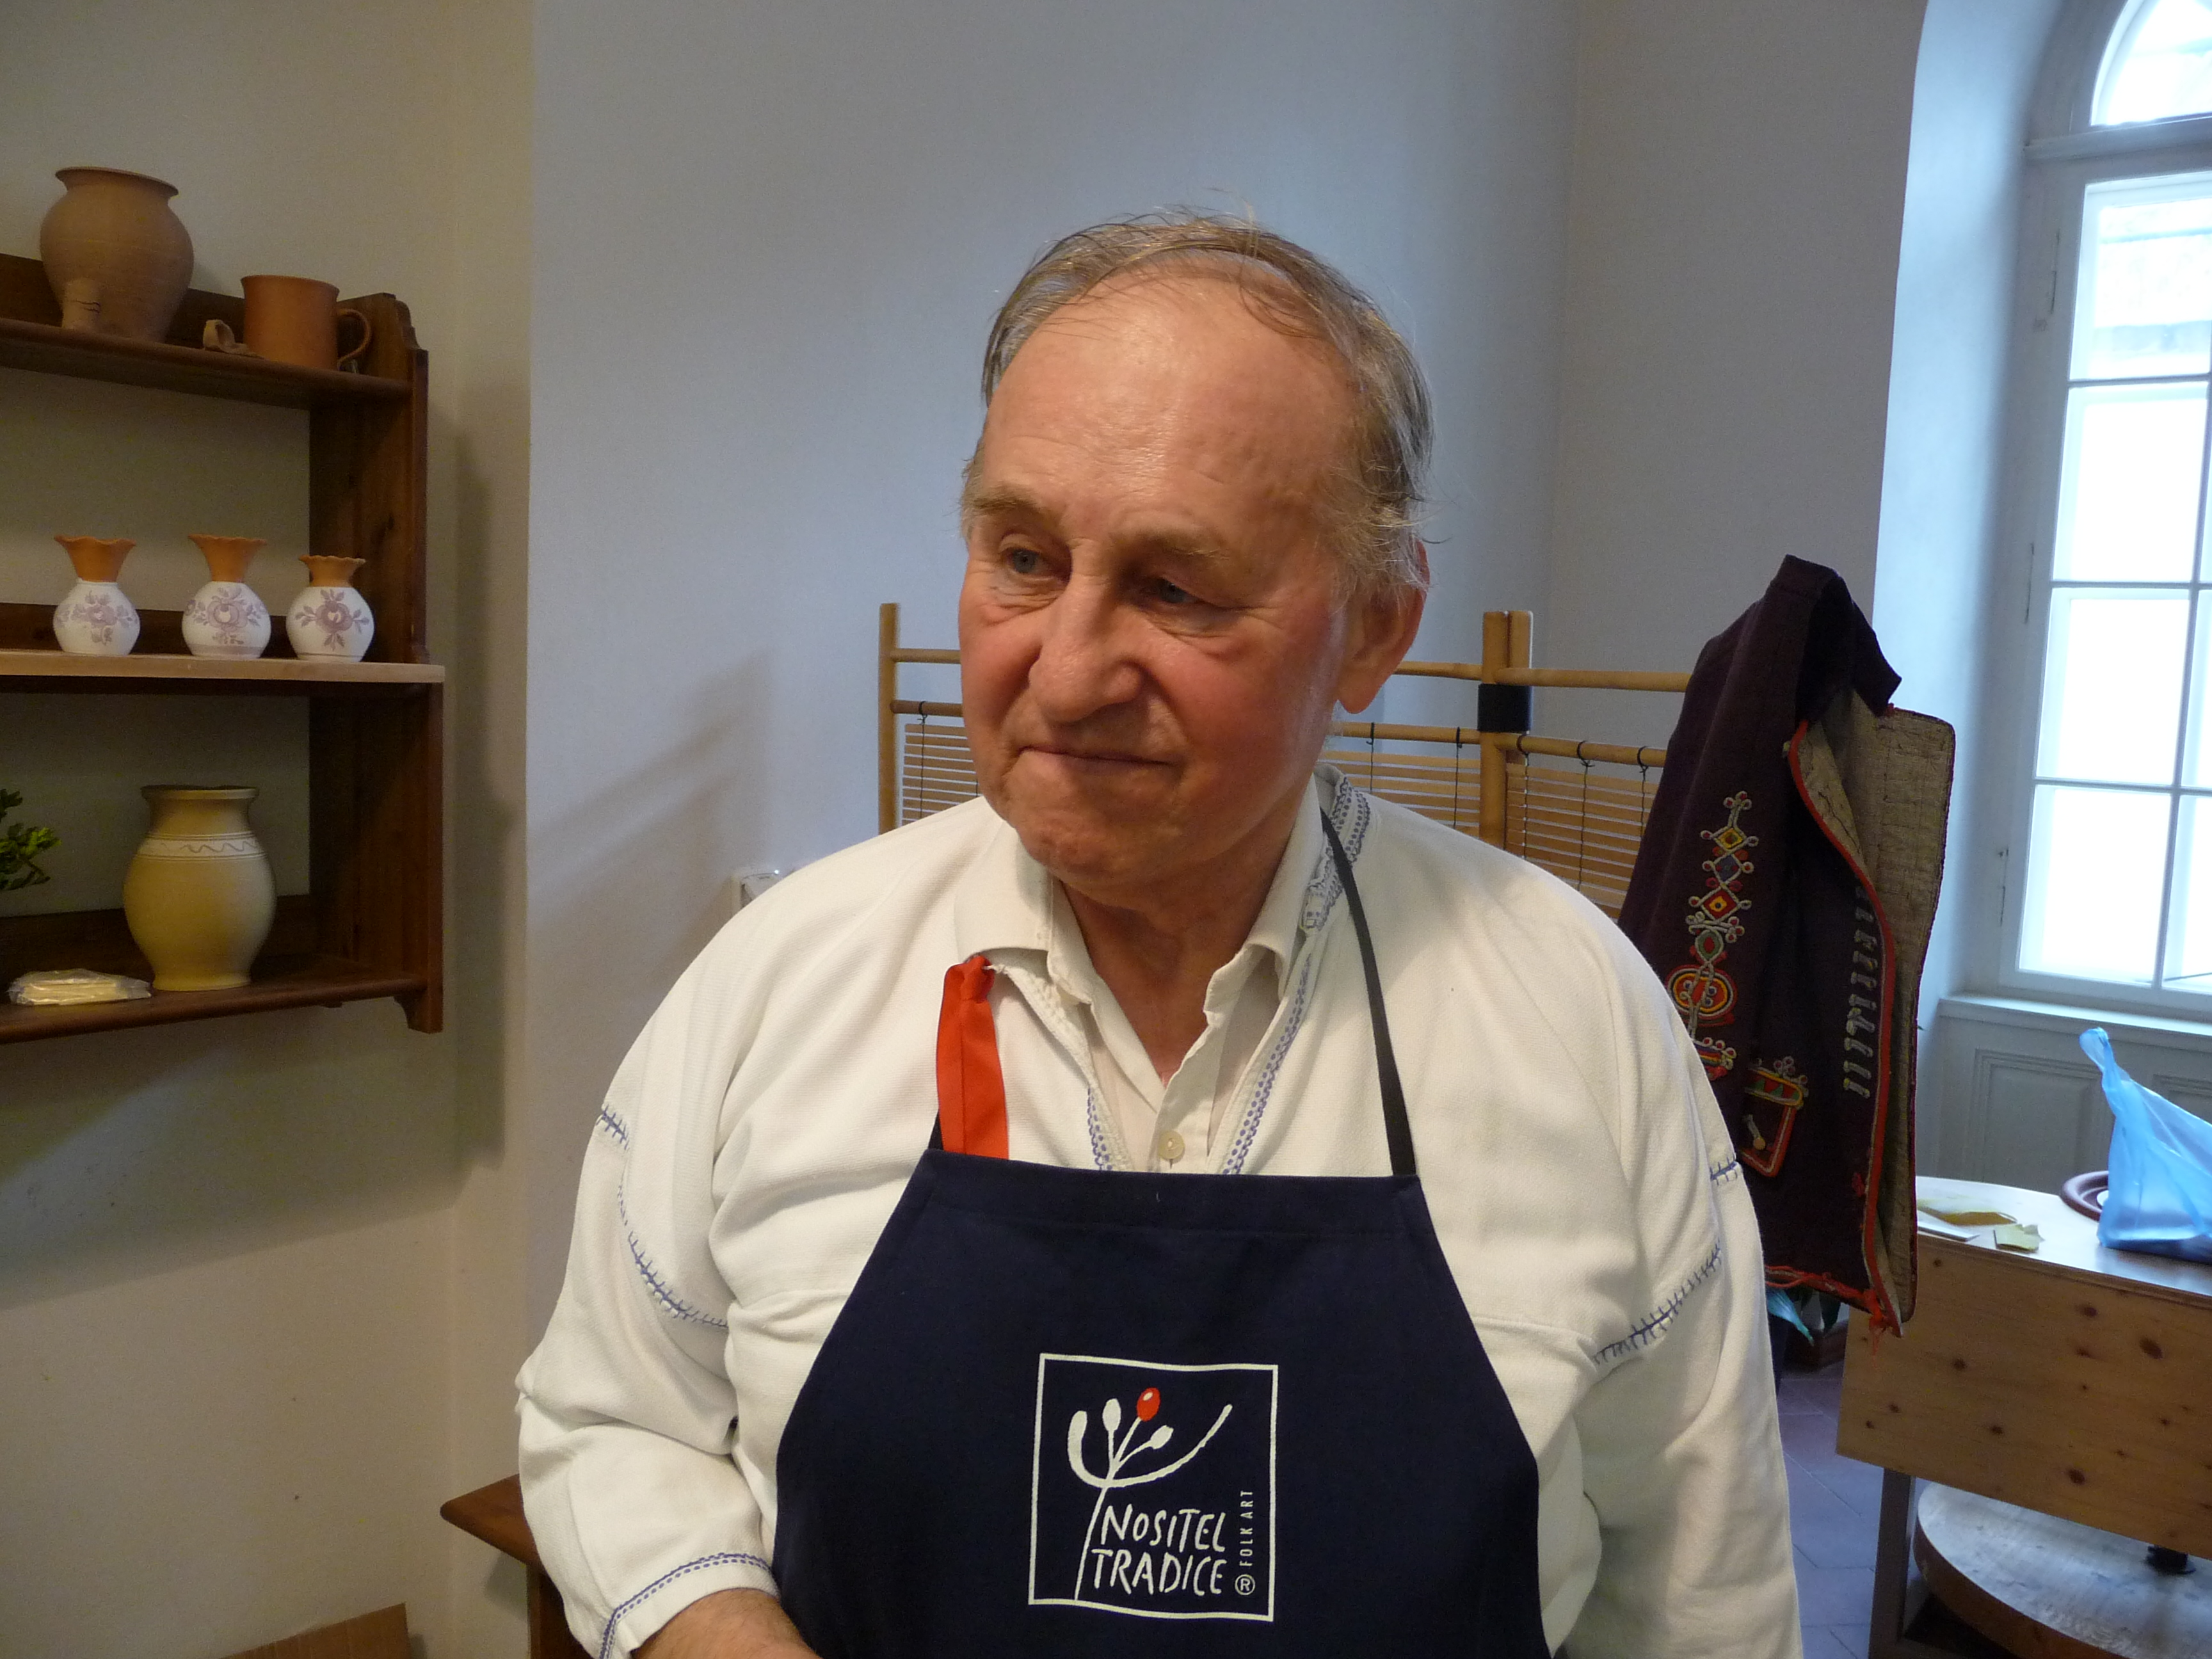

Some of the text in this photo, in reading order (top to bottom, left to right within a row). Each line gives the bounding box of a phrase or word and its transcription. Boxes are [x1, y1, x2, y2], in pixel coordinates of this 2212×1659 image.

[1101, 1503, 1226, 1553] NOSITEL
[1239, 1490, 1253, 1567] FOLK ART
[1091, 1548, 1228, 1596] TRADICE
